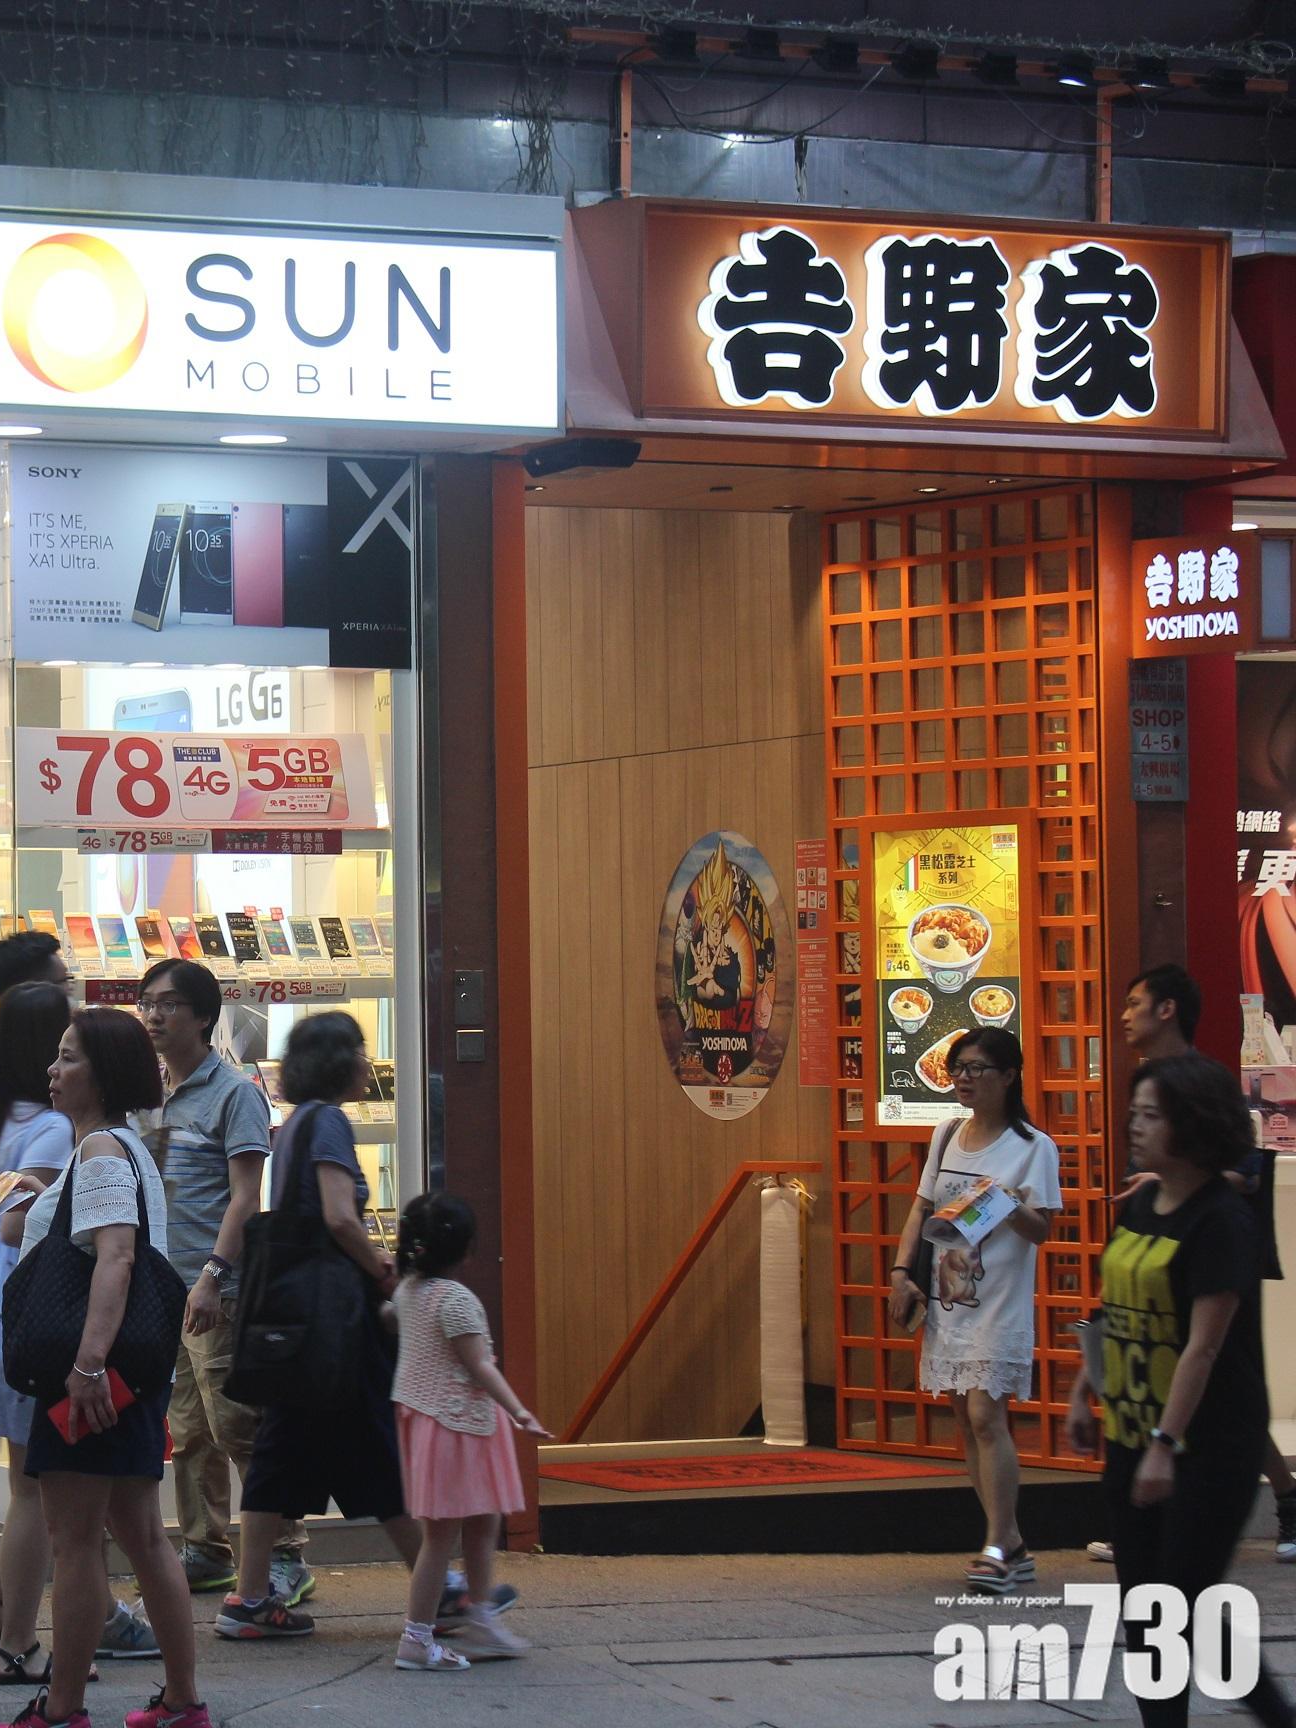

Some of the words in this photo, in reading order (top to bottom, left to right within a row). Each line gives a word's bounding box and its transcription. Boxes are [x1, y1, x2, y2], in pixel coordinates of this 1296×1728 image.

[184, 253, 451, 354] SUN
[700, 226, 1160, 424] 吉野家
[185, 358, 452, 401] MOBILE
[27, 466, 83, 479] SONY
[28, 512, 56, 530] IT'S
[60, 513, 87, 532] ME,
[28, 533, 56, 550] IT'S
[59, 534, 114, 551] XPERIA
[185, 529, 208, 552] 10
[209, 534, 222, 545] 35
[28, 553, 55, 569] XA1
[60, 554, 101, 571] Ultra.
[1144, 545, 1240, 608] 吉野家
[342, 622, 380, 632] XPERIA
[216, 683, 243, 728] LG
[248, 671, 282, 721] G6
[1132, 708, 1185, 728] SHOP
[177, 747, 192, 756] THE
[197, 747, 217, 756] CLUB
[247, 747, 330, 792] 5GB
[183, 765, 231, 796] 4G
[82, 838, 101, 849] 4G
[150, 831, 173, 845] 5GB
[919, 854, 977, 871] 黑松露芝士
[938, 872, 959, 885] 系列
[893, 960, 910, 972] $46
[100, 993, 134, 1001] 大新信用
[223, 987, 242, 999] 4G
[289, 981, 312, 996] 5GB
[737, 1000, 754, 1033] Z
[702, 1036, 748, 1052] YOSHINOYA
[891, 1044, 906, 1055] $46
